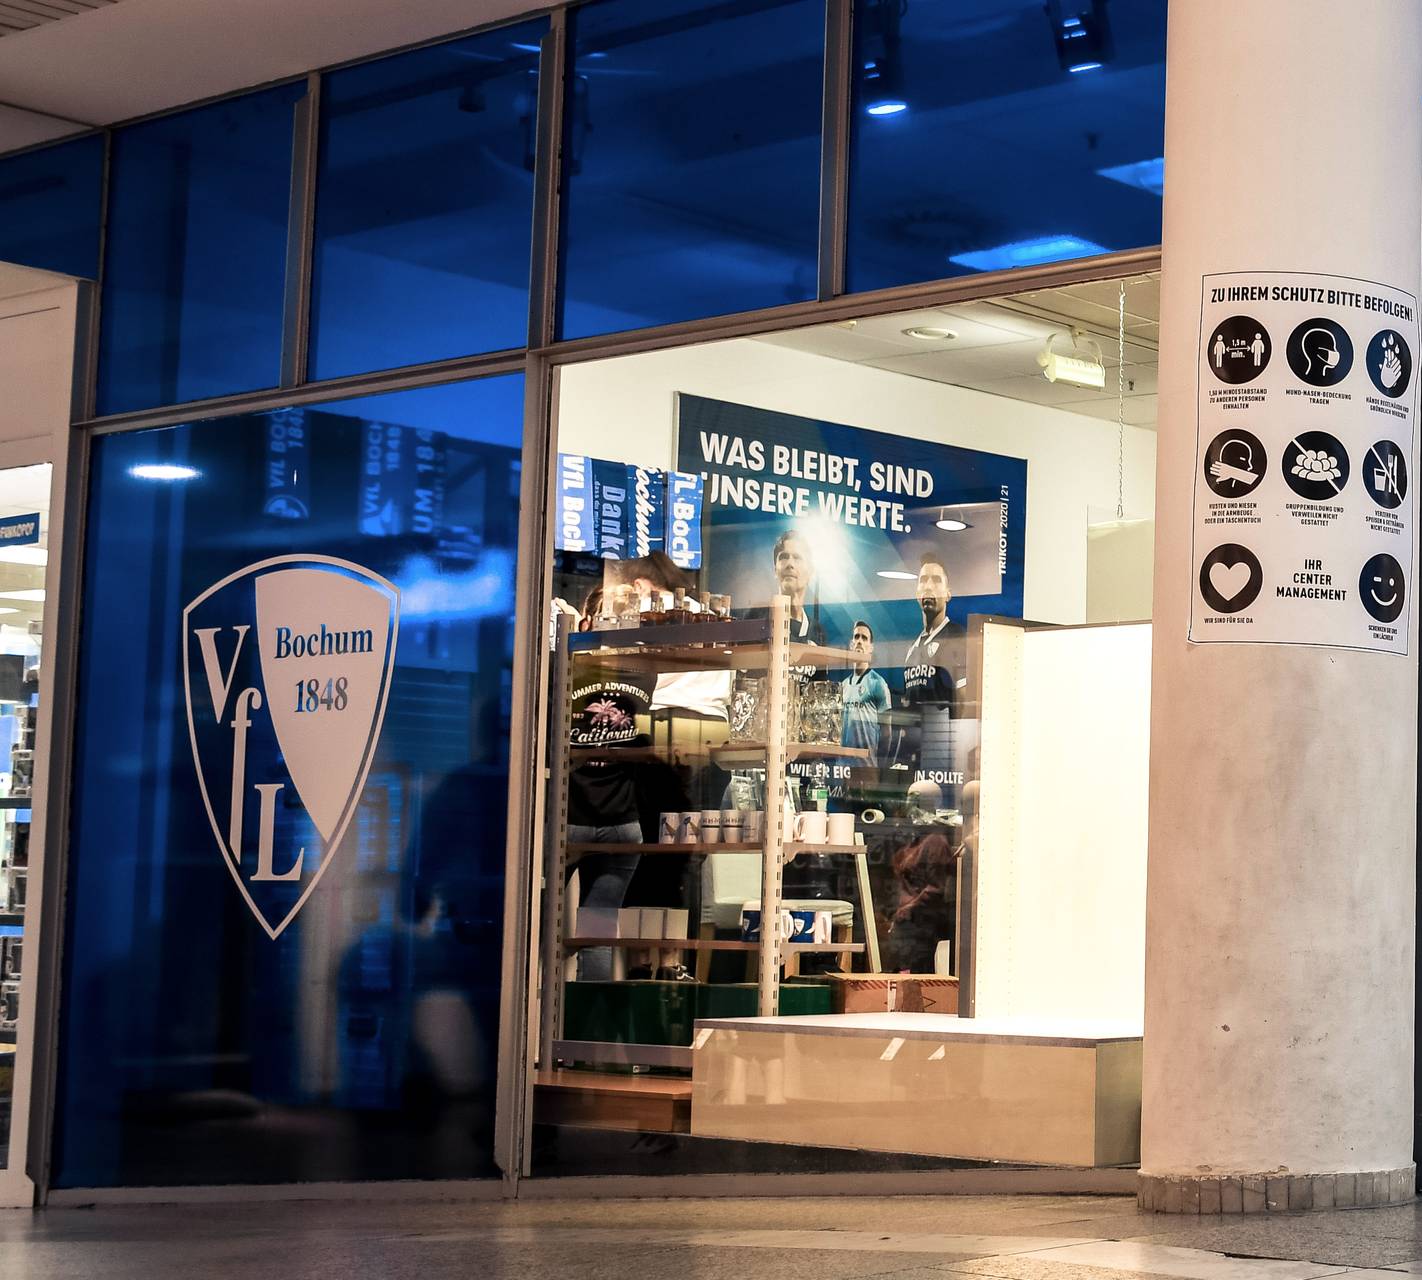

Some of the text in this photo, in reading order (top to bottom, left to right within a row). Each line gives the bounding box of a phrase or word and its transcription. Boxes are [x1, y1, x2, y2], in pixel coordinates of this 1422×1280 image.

[1211, 286, 1413, 322] ZU IHREM SCHUTZ BITTE BEFOLGEN!
[1231, 350, 1246, 358] min.
[1223, 388, 1268, 396] MINDESTABSTAND
[1286, 389, 1352, 400] MUND-NASEN-BEDECKUNG
[700, 431, 934, 498] WAS BLEIBT, SIND
[817, 490, 912, 534] WERTE.
[1286, 503, 1332, 512] GRUPPENBILDUNG
[999, 530, 1008, 576] TRIKOT
[1304, 559, 1322, 570] IHR
[1293, 572, 1332, 586] CENTER
[1276, 586, 1347, 601] MANAGEMENT
[1227, 616, 1236, 624] FÜR
[274, 623, 374, 659] Bochum
[294, 676, 348, 714] 1848
[604, 682, 650, 703] ADVENTURES
[569, 725, 640, 744] California
[928, 771, 964, 784] SOLLTE
